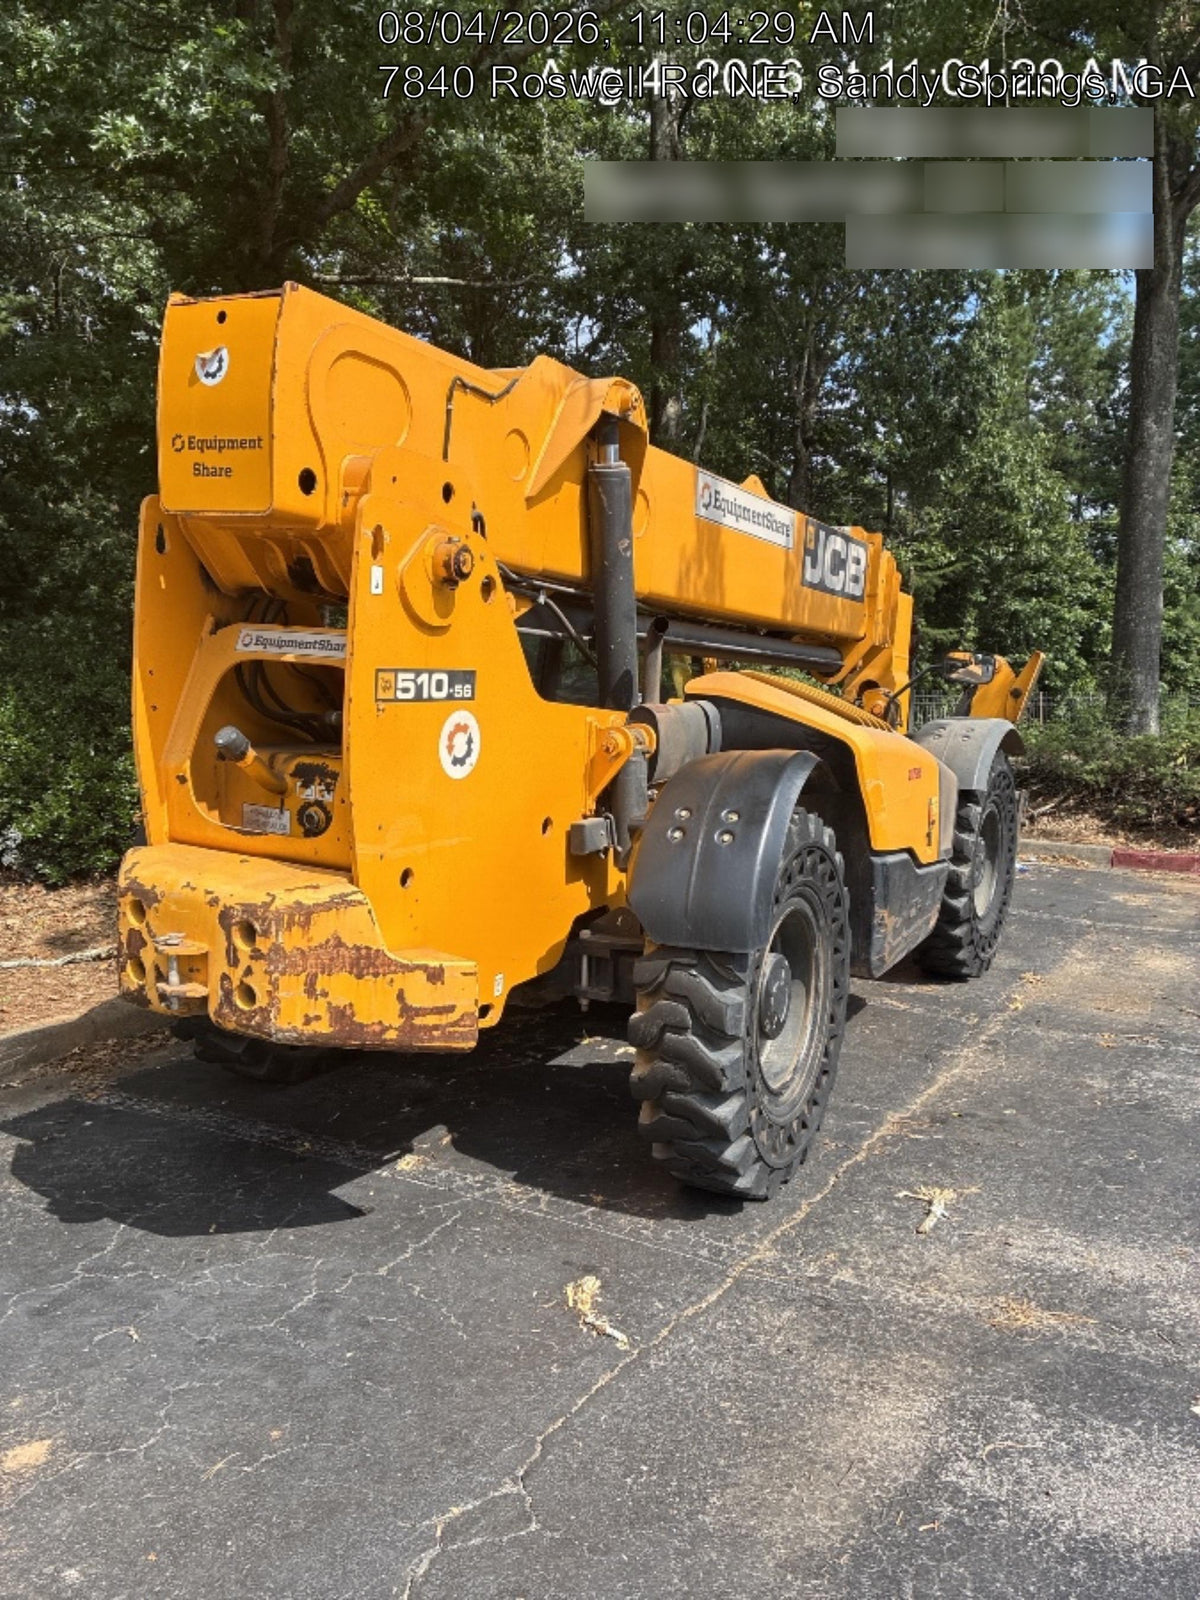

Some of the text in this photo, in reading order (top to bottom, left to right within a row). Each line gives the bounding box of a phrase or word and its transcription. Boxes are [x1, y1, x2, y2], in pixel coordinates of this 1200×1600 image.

[187, 434, 263, 453] Equipment
[192, 461, 232, 477] Share
[713, 489, 791, 537] EquipmentShare
[803, 528, 866, 597] JCB
[254, 634, 346, 652] EquipmentShar
[395, 671, 472, 700] 510-56
